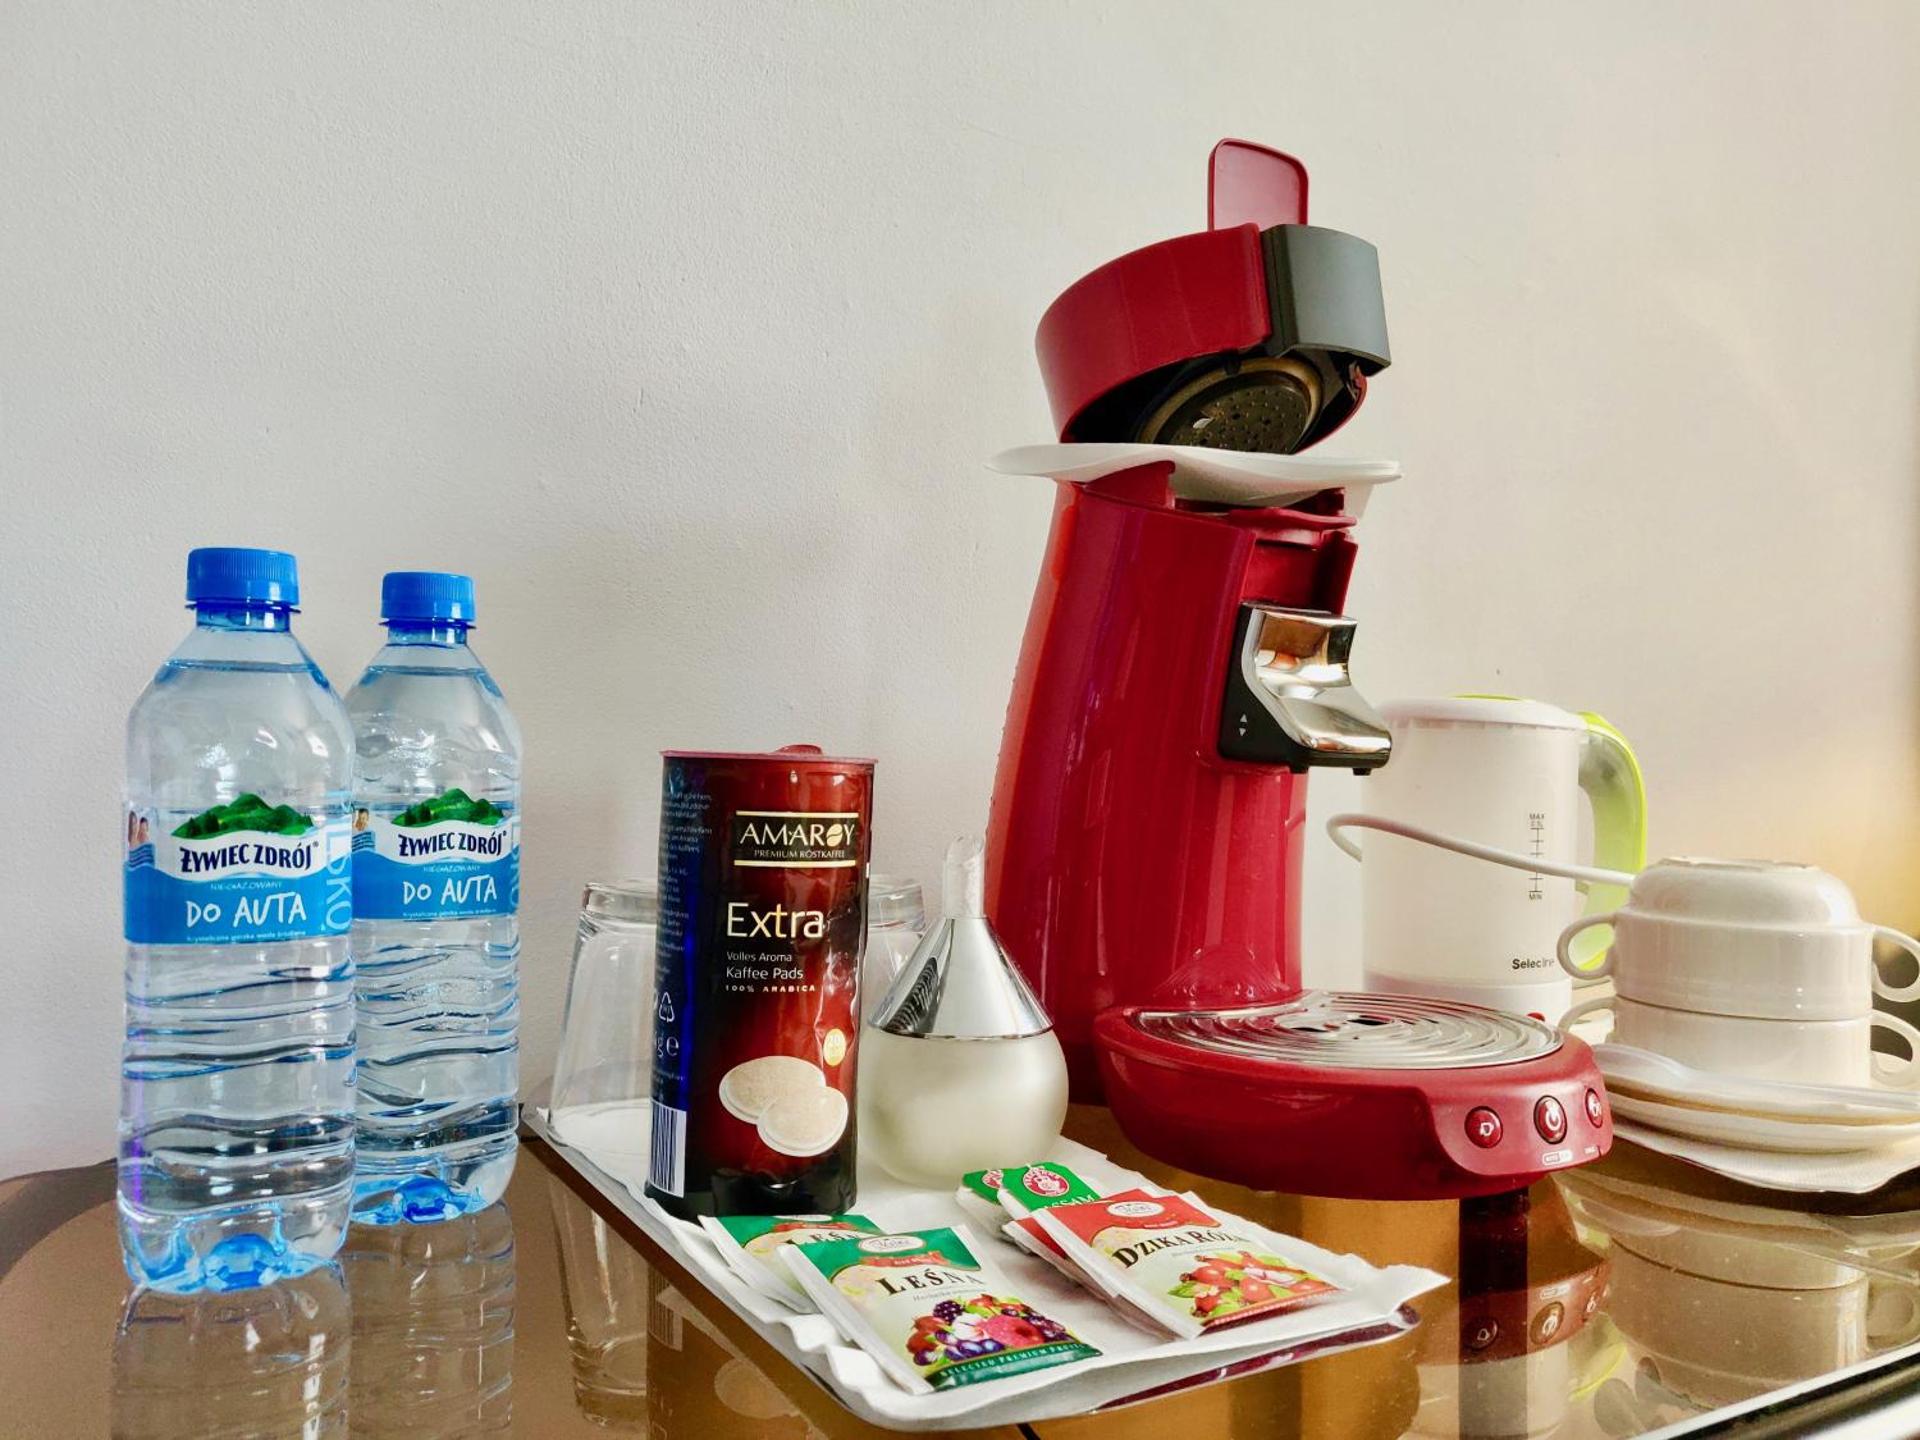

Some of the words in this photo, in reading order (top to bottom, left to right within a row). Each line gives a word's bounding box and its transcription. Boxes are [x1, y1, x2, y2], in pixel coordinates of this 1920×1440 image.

[398, 832, 455, 857] ŻYWIEC
[458, 831, 502, 856] ZDRÓJ
[739, 822, 855, 847] AMAROY
[179, 843, 250, 873] ŻYWIEC
[253, 841, 311, 870] ZDRÓJ
[754, 849, 798, 858] PREMIUM
[403, 881, 432, 905] DO
[440, 874, 497, 905] AUTA
[186, 900, 222, 928] DO
[232, 891, 307, 928] AUTA
[727, 902, 824, 938] Extra
[726, 951, 756, 961] Volles
[759, 952, 792, 962] Aroma
[726, 966, 768, 979] Kaffee
[773, 967, 804, 979] Pads
[725, 984, 754, 993] 100%
[763, 985, 815, 993] ARABICA
[1112, 1235, 1194, 1268] DZIKA
[875, 1268, 986, 1296] LEŚNA
[1000, 1348, 1047, 1364] PREMIUM
